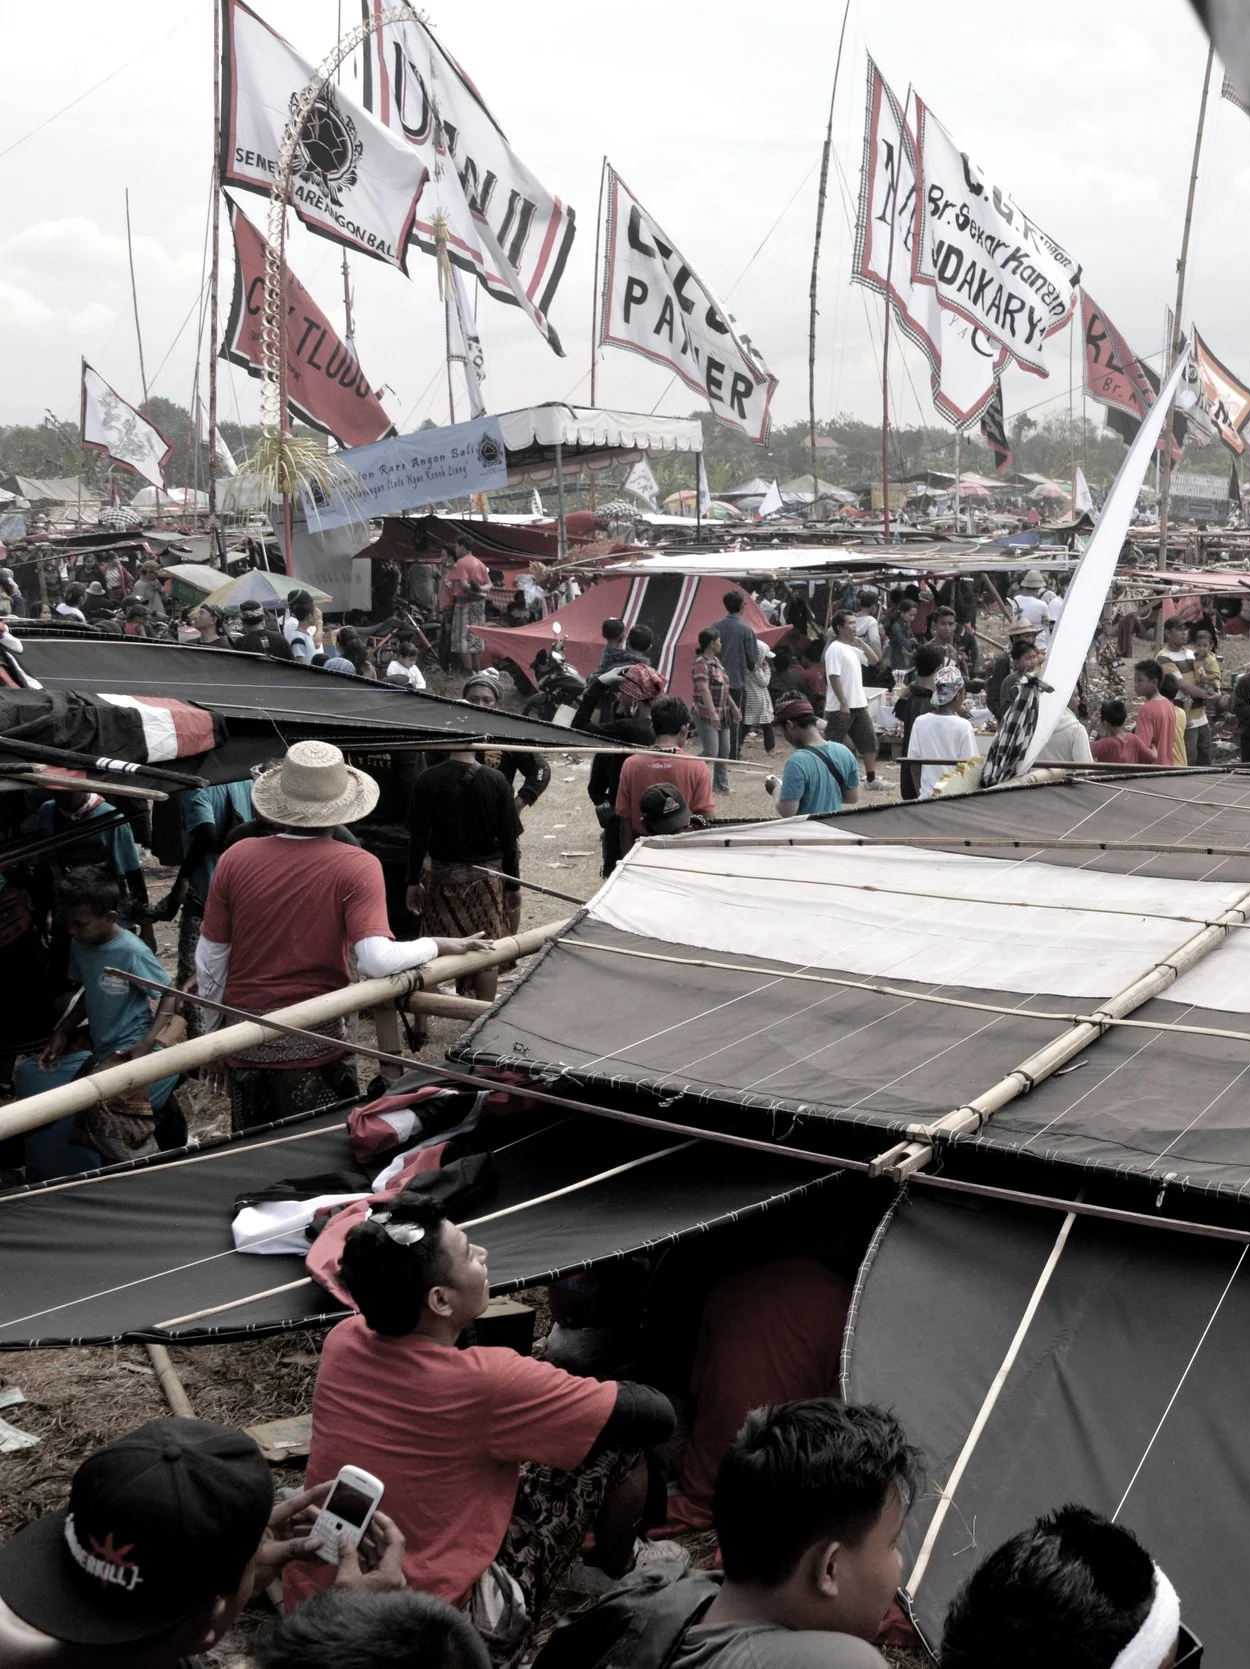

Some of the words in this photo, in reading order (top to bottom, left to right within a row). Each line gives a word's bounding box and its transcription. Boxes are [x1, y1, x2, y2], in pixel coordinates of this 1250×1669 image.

[379, 463, 406, 476] Rare
[411, 453, 446, 470] Angon
[451, 443, 475, 458] Bali
